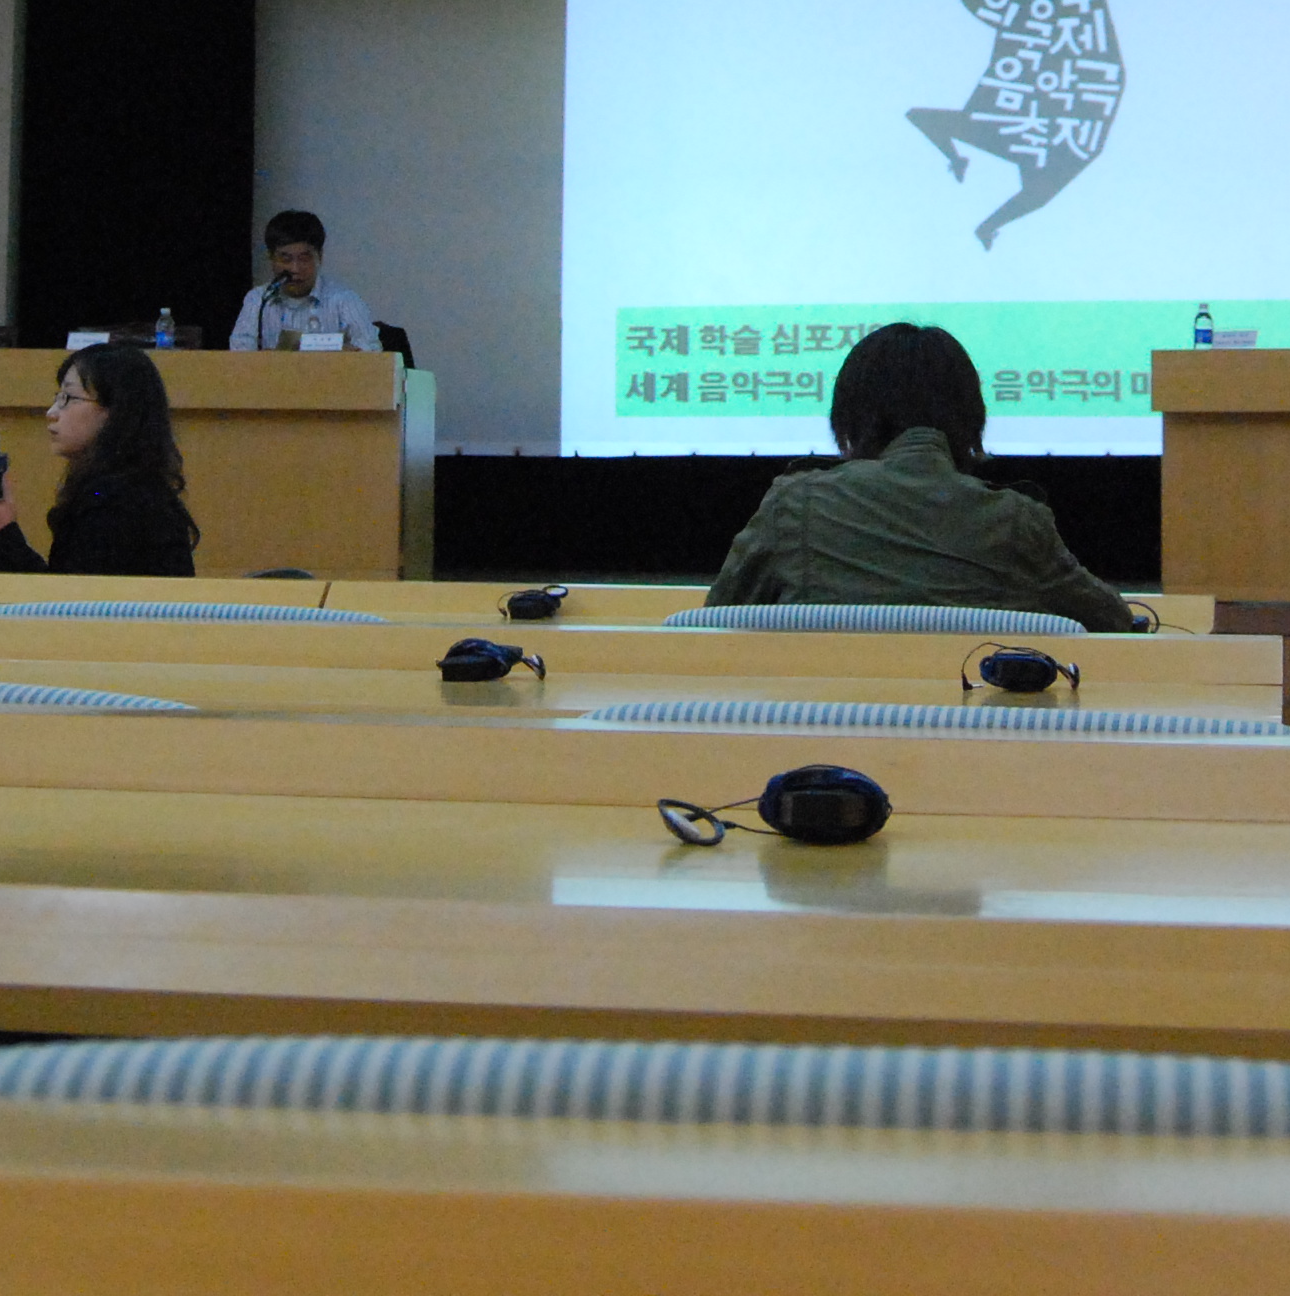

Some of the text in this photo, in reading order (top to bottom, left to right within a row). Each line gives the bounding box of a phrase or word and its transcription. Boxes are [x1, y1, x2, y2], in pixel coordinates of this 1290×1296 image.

[1001, 9, 1107, 71] 국제
[980, 56, 1121, 116] 음악극
[970, 101, 1103, 168] 축제
[626, 323, 878, 356] 국제 학술 심포지
[626, 372, 688, 403] 세계
[699, 371, 824, 402] 음악극의
[992, 369, 1122, 401] 음악극의
